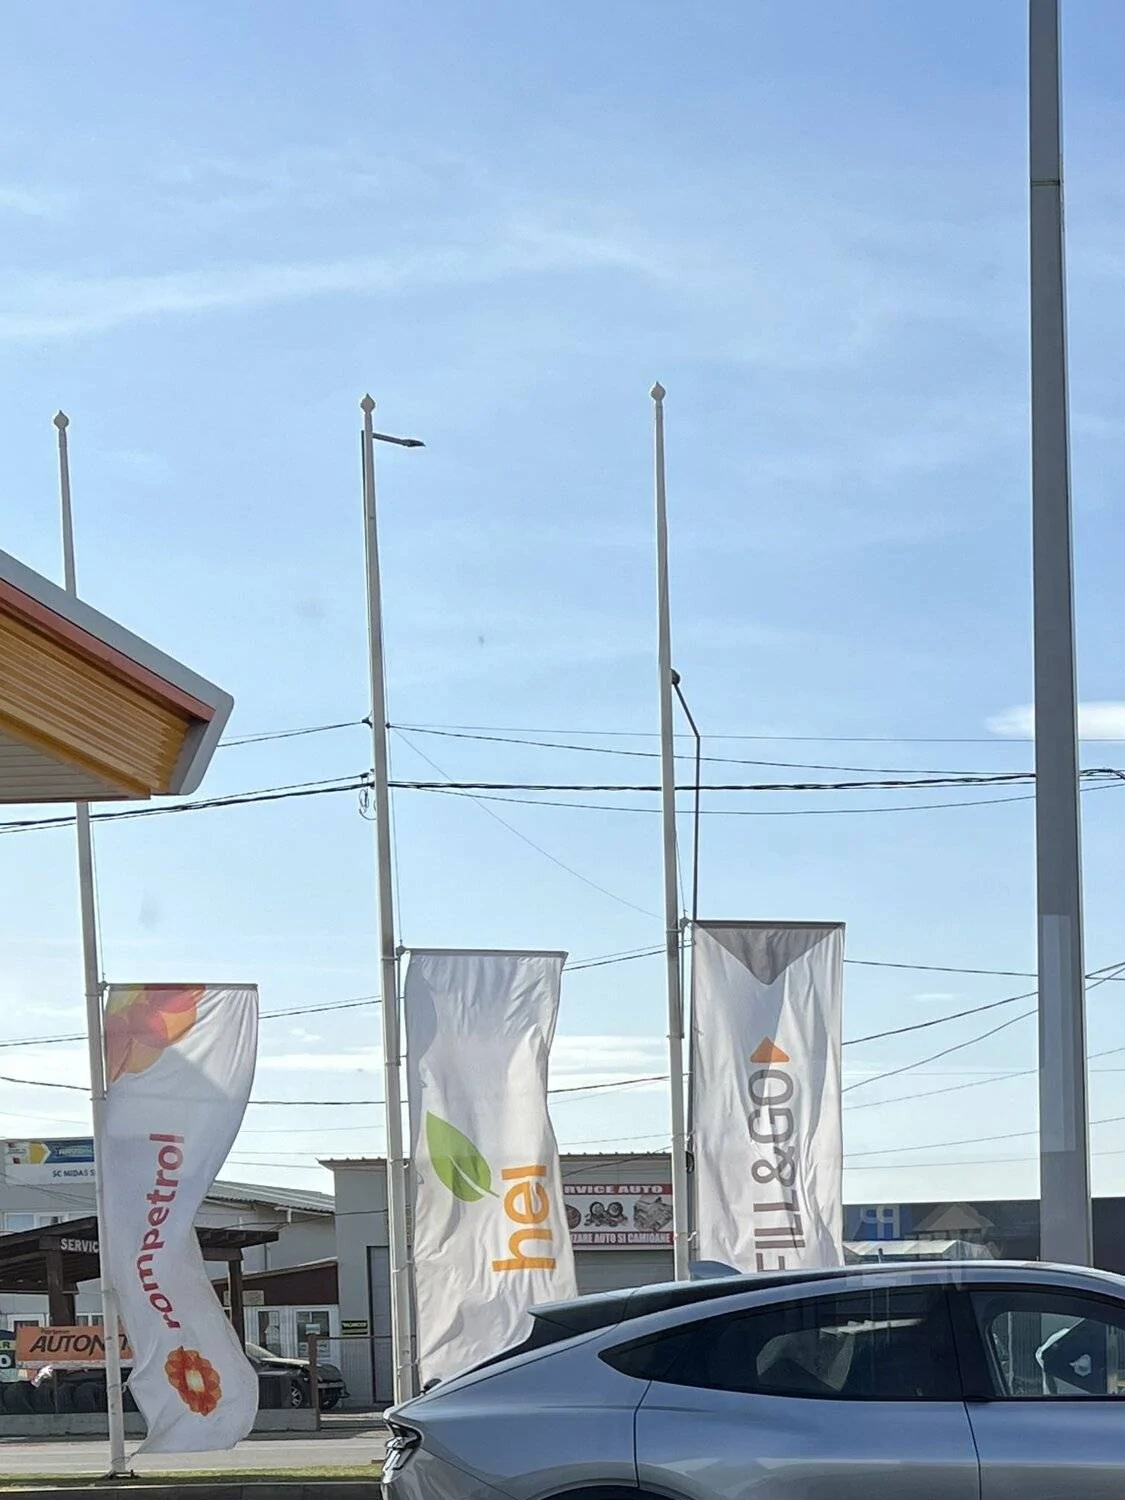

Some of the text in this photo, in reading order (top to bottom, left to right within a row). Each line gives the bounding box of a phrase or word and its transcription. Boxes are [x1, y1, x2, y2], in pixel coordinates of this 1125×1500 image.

[748, 1069, 806, 1272] FILL&GO
[564, 1185, 663, 1194] RVICE AUTO
[137, 1133, 185, 1329] rompetrol
[60, 1238, 99, 1252] SERVIC
[594, 1233, 616, 1244] AUTO
